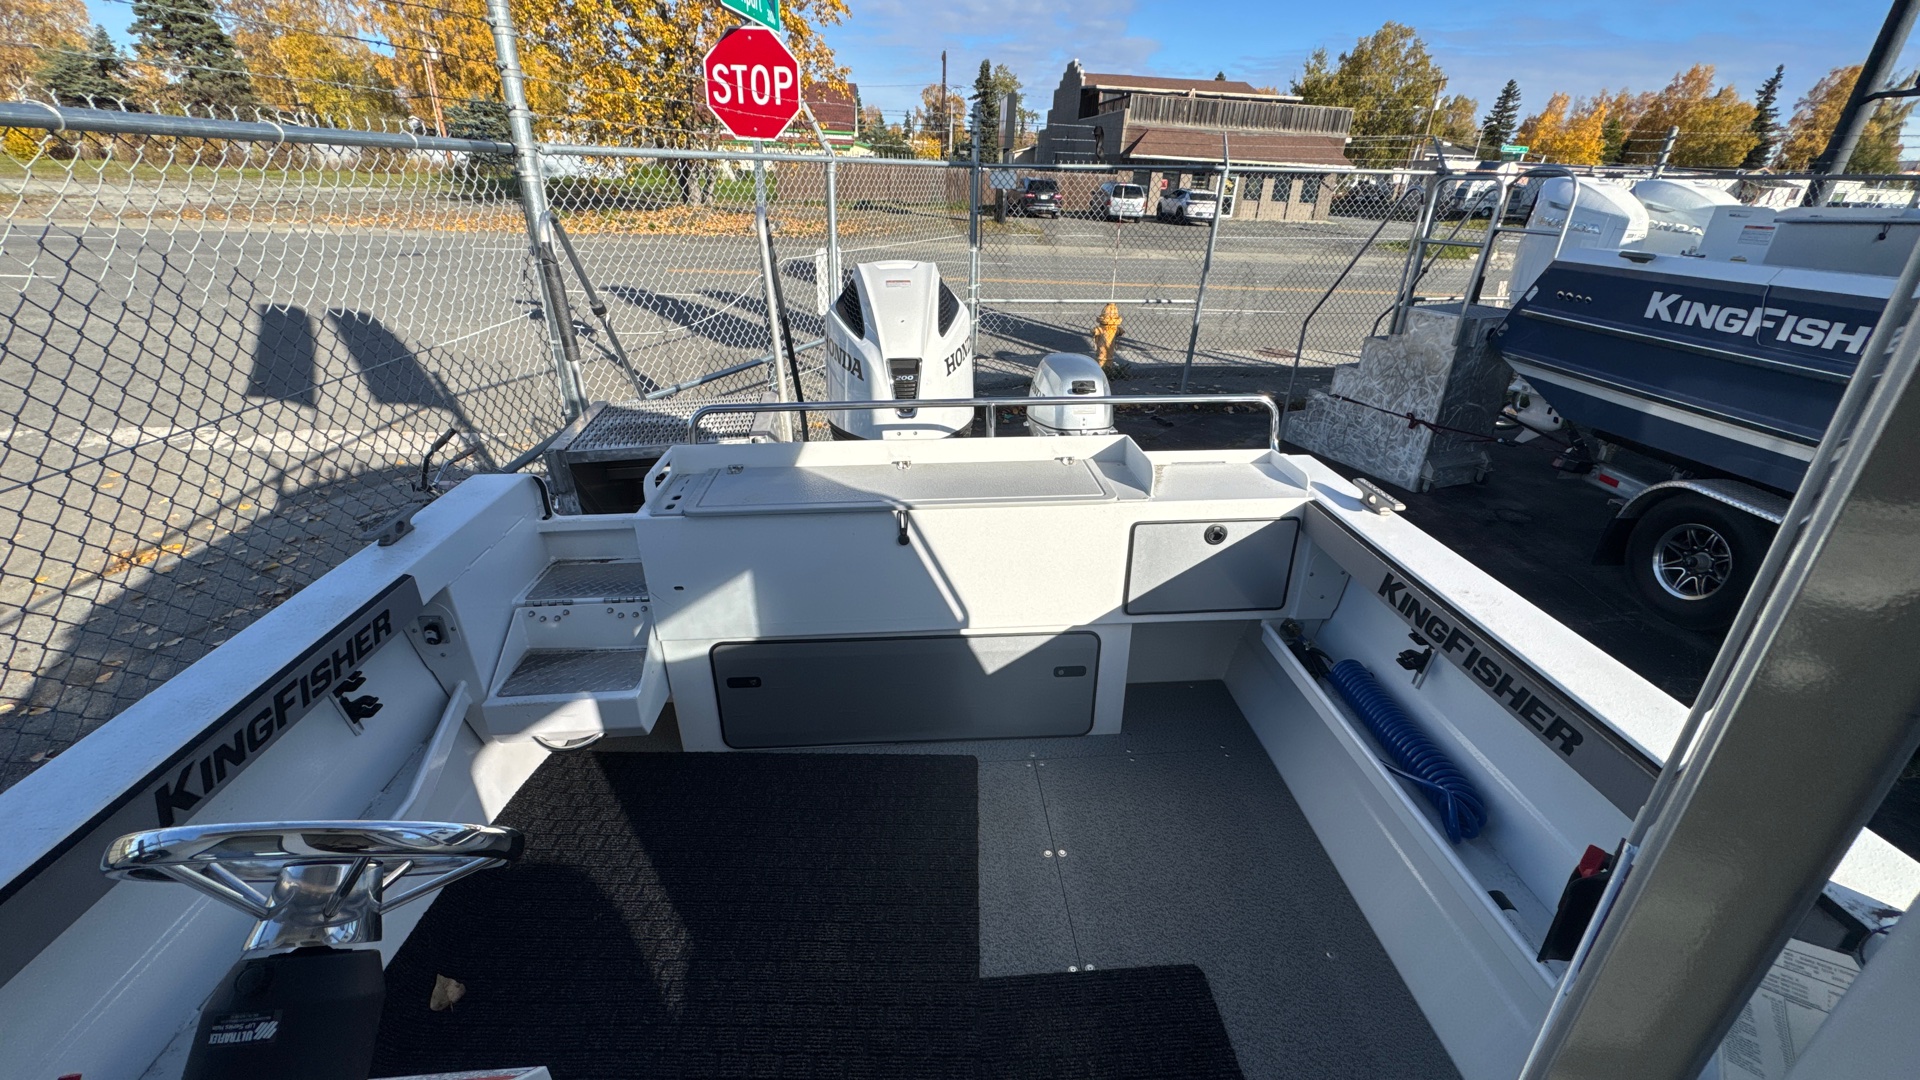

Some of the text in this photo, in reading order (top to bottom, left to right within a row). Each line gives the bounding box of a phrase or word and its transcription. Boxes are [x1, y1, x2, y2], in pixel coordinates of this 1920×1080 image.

[712, 63, 793, 105] STOP
[1648, 219, 1704, 237] ONDA
[827, 336, 864, 381] ONDA
[1378, 572, 1584, 757] KINGFISHER
[154, 609, 392, 827] KINGFISHER
[208, 1030, 254, 1044] ULTRAFLEX
